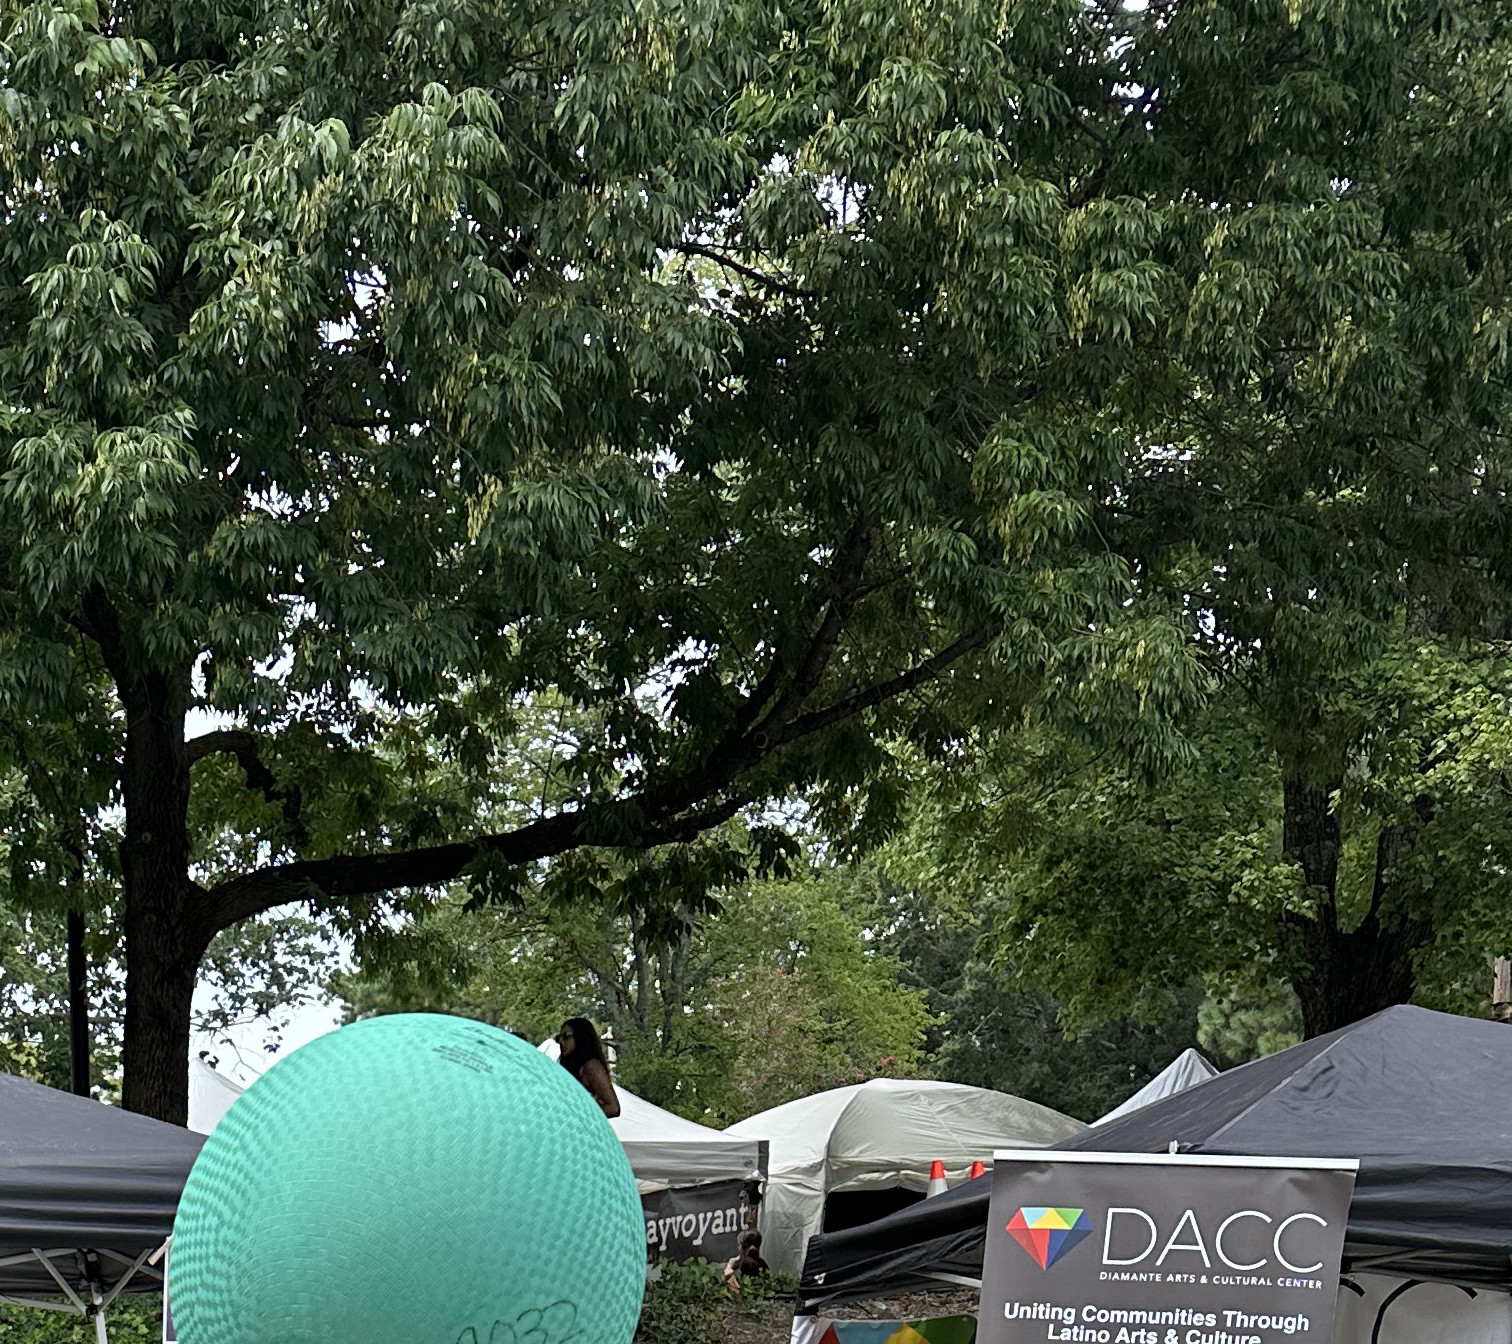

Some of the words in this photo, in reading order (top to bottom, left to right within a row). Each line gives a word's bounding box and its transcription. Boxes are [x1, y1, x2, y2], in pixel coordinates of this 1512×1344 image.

[646, 1203, 750, 1251] ayvoyant
[1103, 1208, 1327, 1272] DACC
[1100, 1272, 1162, 1281] DIAMANTE
[1167, 1274, 1195, 1283] ARTS
[1200, 1275, 1207, 1283] &
[1213, 1276, 1272, 1285] CULTURAL
[1278, 1278, 1322, 1289] CENTER
[1005, 1303, 1075, 1324] Uniting
[1082, 1305, 1216, 1326] Communities
[1223, 1311, 1309, 1334] Through
[1048, 1324, 1110, 1343] Latino
[1115, 1327, 1157, 1344] Arts
[1164, 1329, 1178, 1344] &
